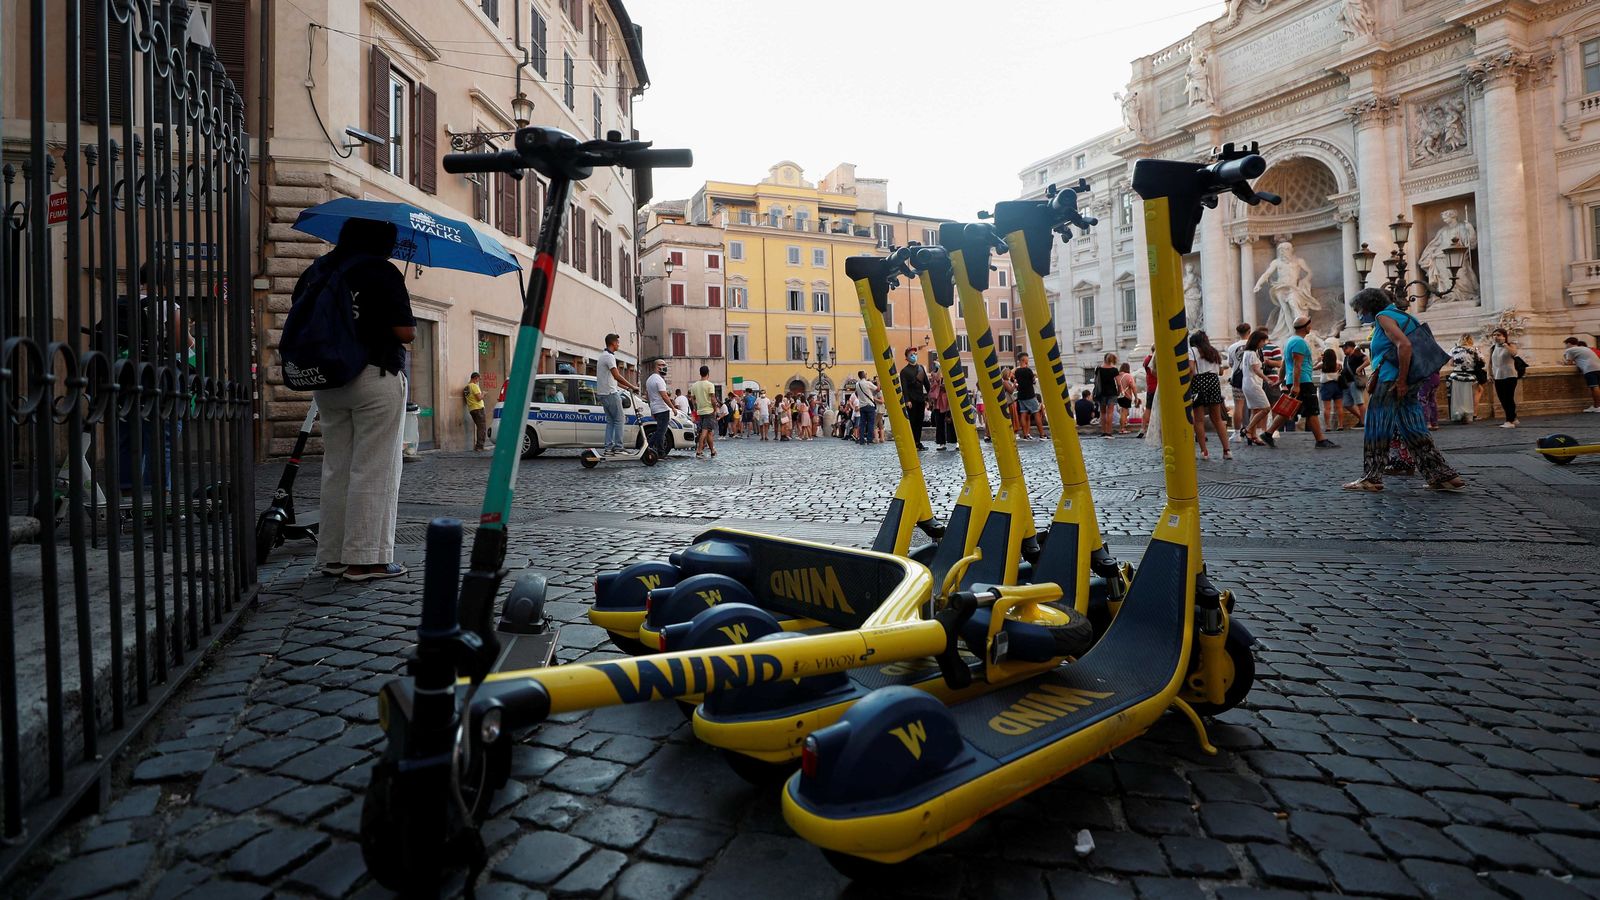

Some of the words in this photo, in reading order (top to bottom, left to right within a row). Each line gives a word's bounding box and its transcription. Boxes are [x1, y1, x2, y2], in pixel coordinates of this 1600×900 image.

[409, 220, 463, 244] WALKS
[435, 223, 461, 236] CITY
[289, 374, 328, 387] WALKS
[301, 366, 320, 378] CITY
[536, 412, 564, 421] POLIZIA
[565, 413, 587, 422] ROMA
[635, 574, 662, 592] W
[769, 565, 857, 616] WIND
[695, 589, 723, 609] W
[717, 622, 749, 646] W
[815, 654, 857, 672] ROMA
[591, 653, 783, 705] WIND
[988, 683, 1117, 737] WIND
[888, 719, 928, 762] W
